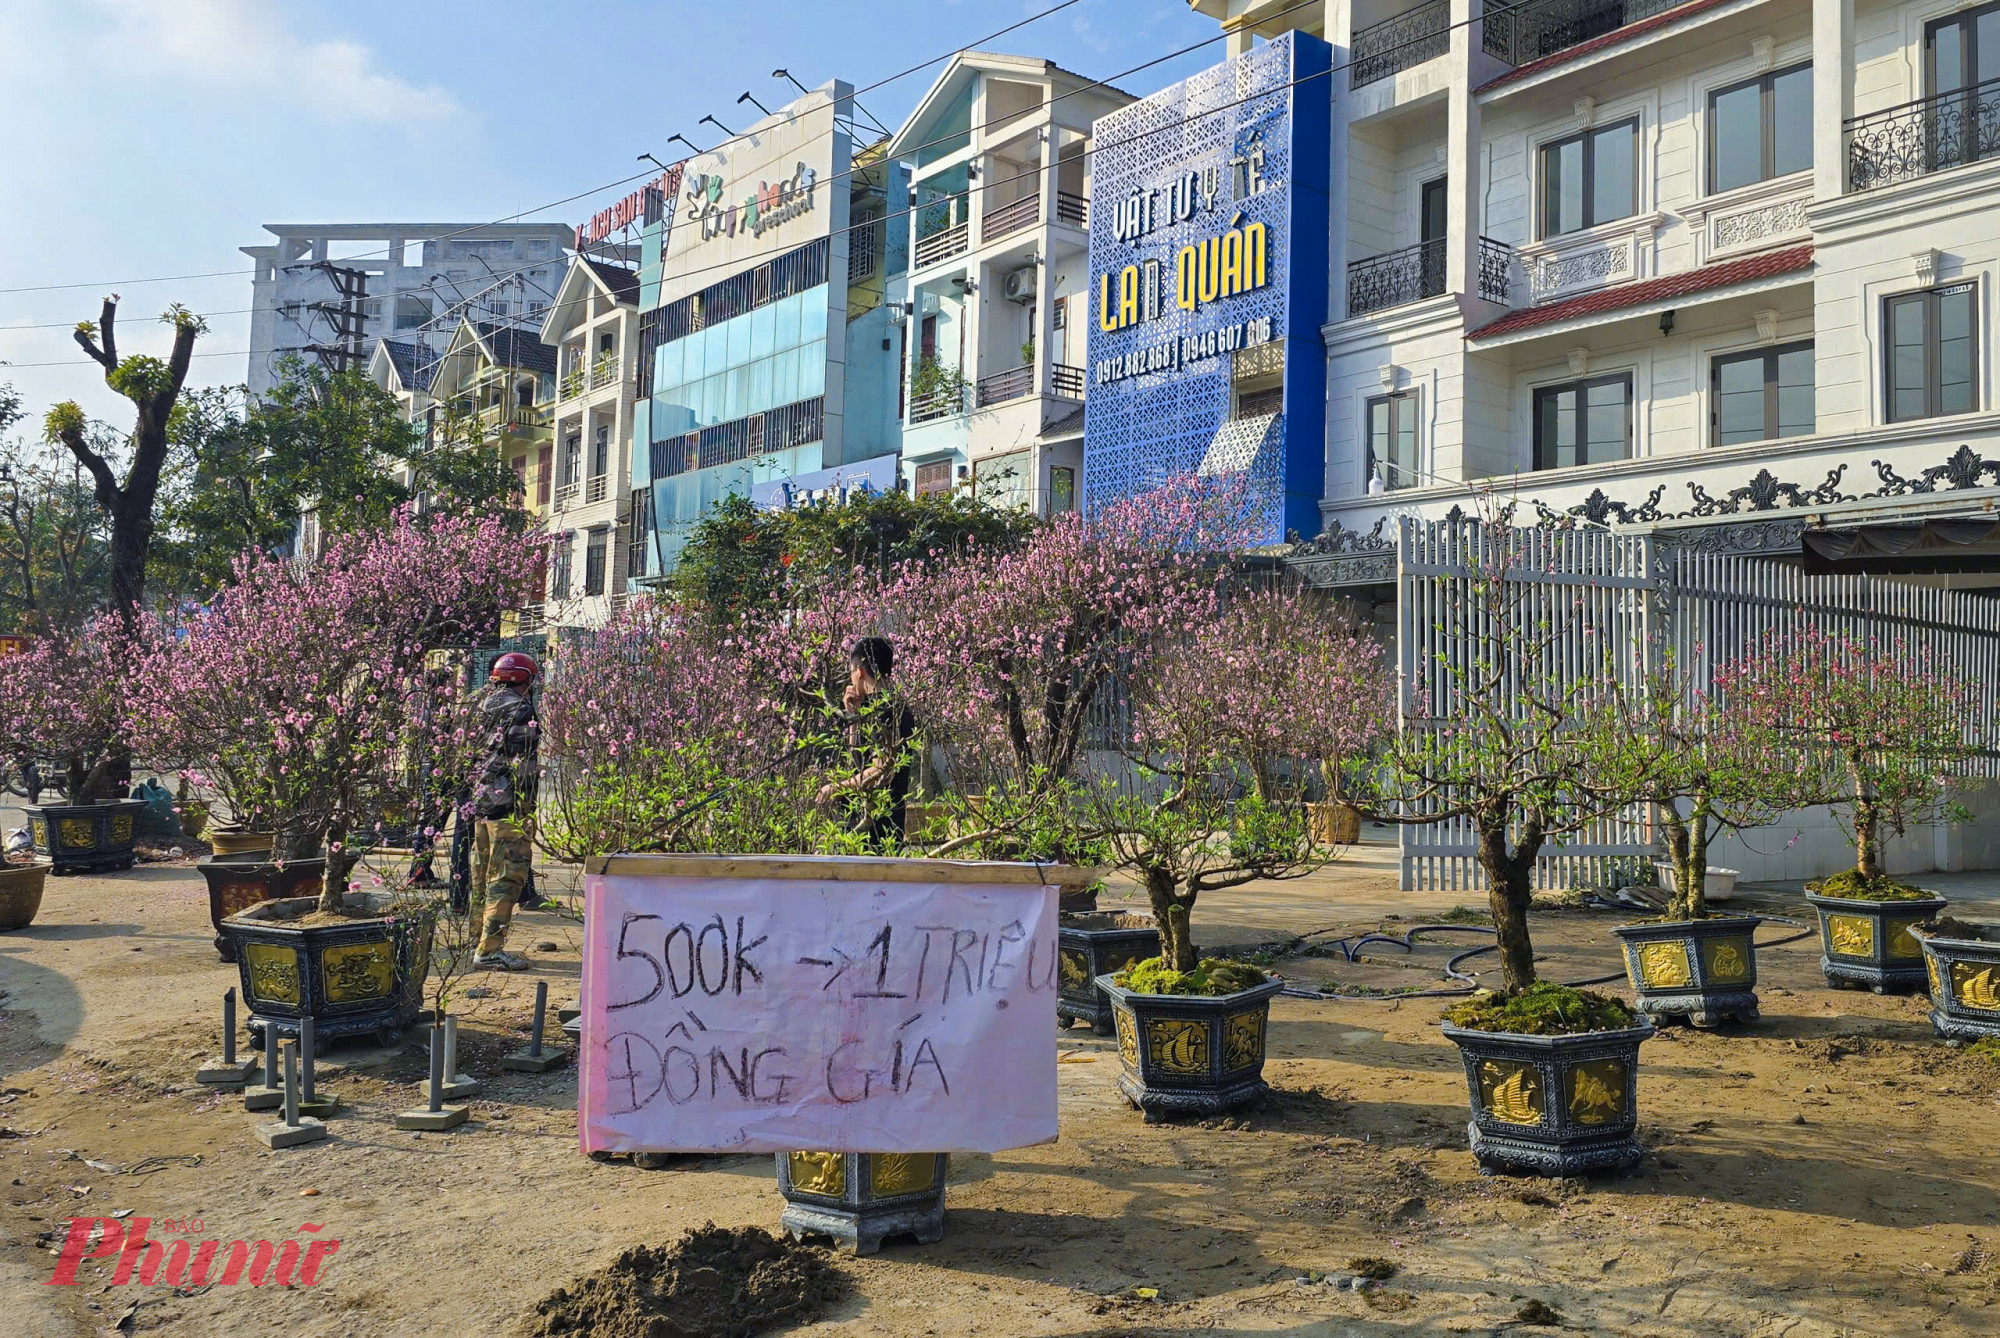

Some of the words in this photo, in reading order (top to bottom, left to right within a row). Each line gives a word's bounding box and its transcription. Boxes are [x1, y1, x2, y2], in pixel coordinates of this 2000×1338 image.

[754, 191, 815, 239] preschool
[1113, 183, 1157, 248] VẬT
[1202, 165, 1218, 211] Y
[1101, 258, 1161, 332] LAN
[1177, 211, 1267, 312] QUÁN
[851, 920, 908, 999] 1
[604, 1006, 800, 1117] ĐỒNG
